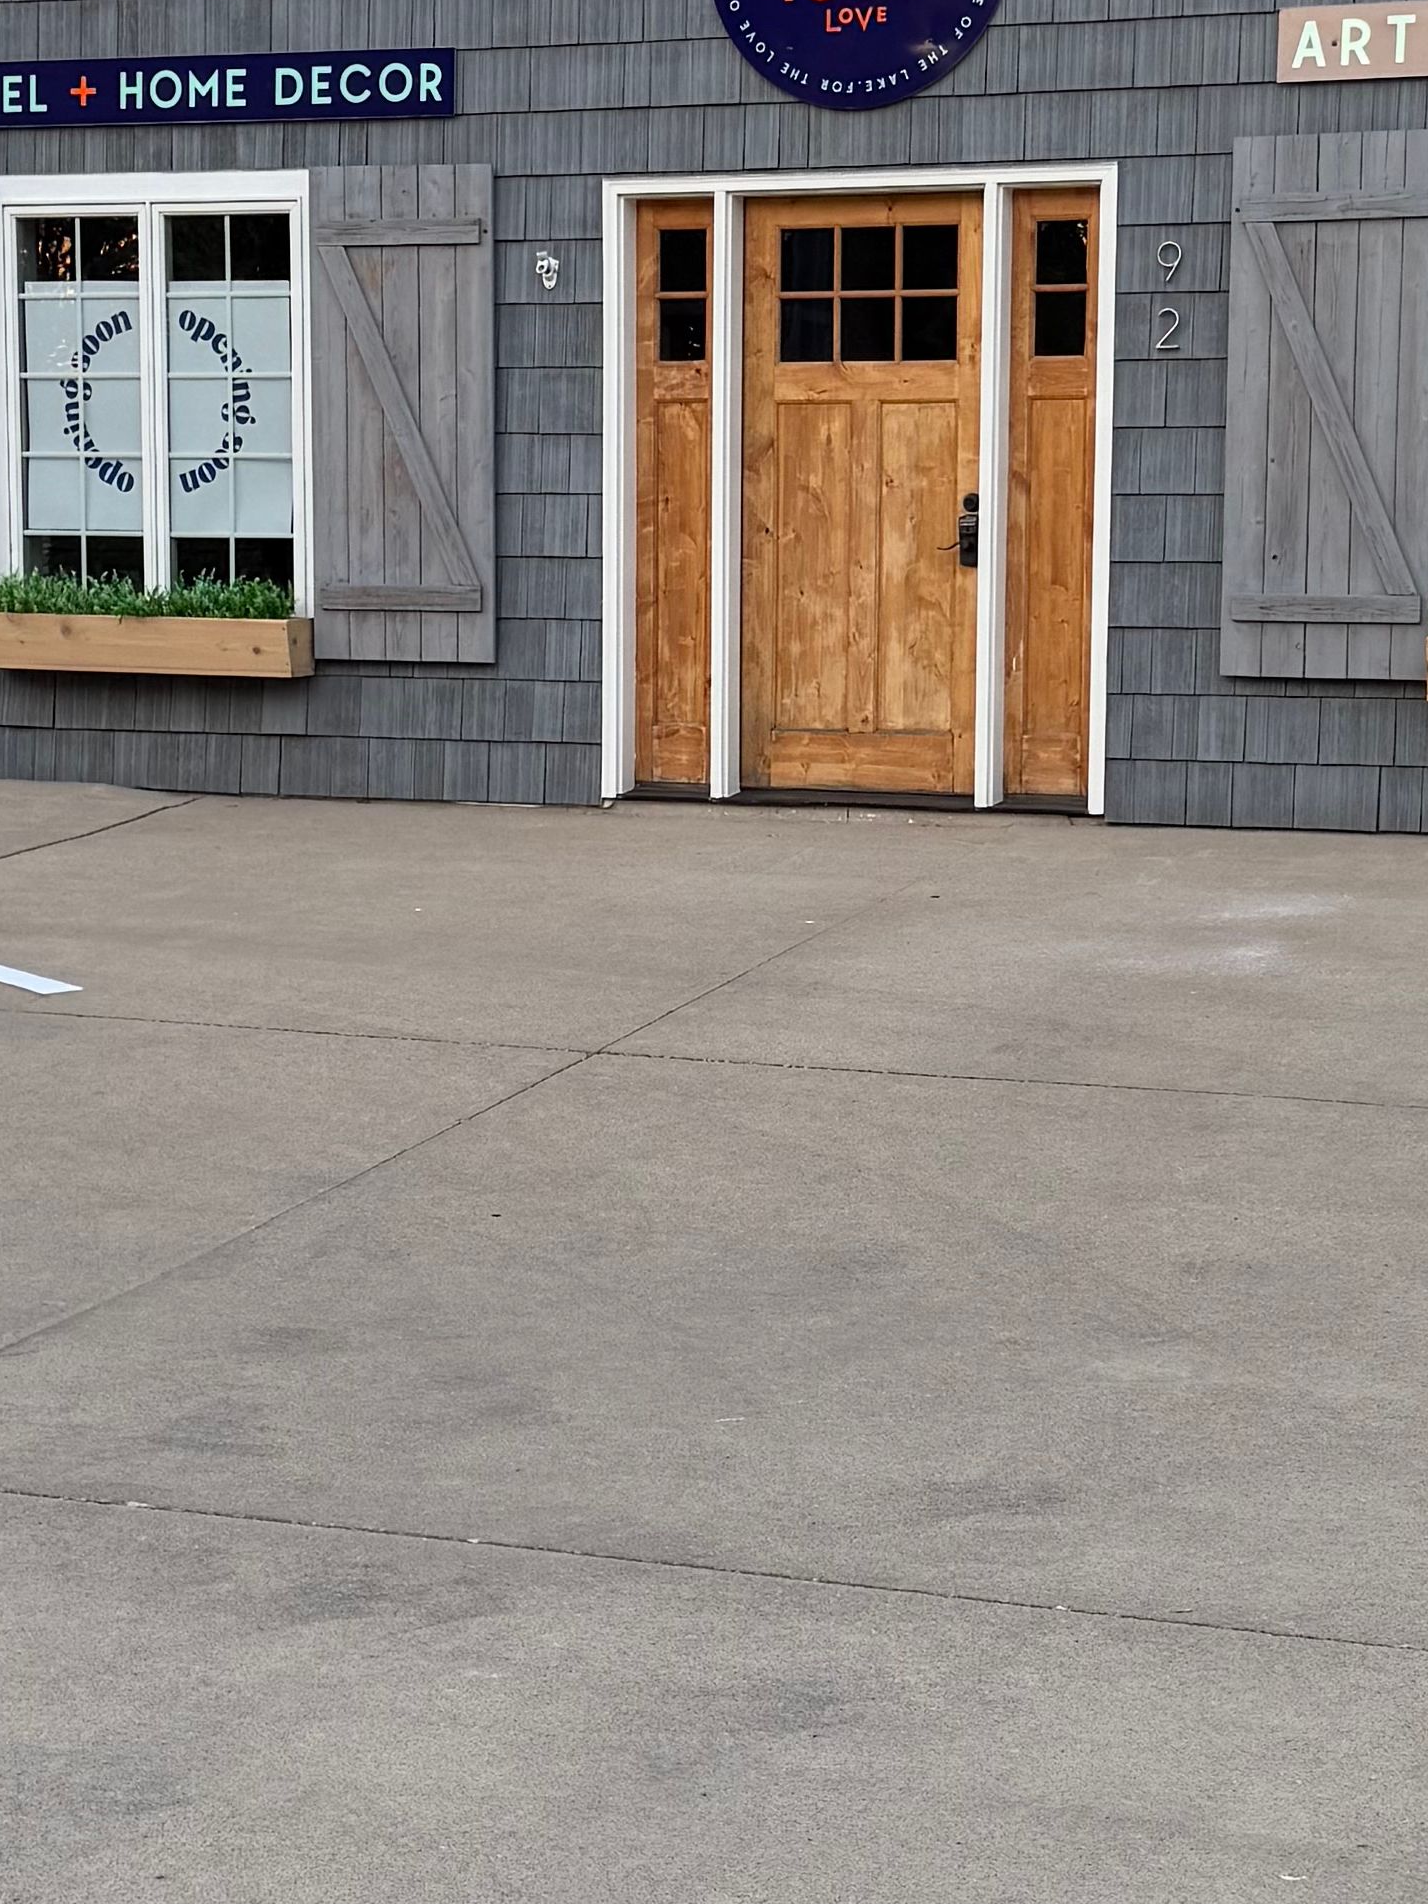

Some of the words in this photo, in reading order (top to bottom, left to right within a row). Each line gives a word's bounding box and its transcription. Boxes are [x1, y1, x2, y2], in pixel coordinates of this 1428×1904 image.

[739, 19, 775, 63] LOVE
[826, 6, 888, 33] LOVE
[954, 16, 972, 39] OF
[1291, 13, 1417, 69] ART
[780, 62, 809, 85] THE
[918, 45, 948, 71] THE
[119, 68, 248, 110] HOME
[274, 62, 444, 106] DECOR
[71, 310, 133, 373] soon
[178, 309, 256, 425] openng
[179, 432, 244, 493] soon
